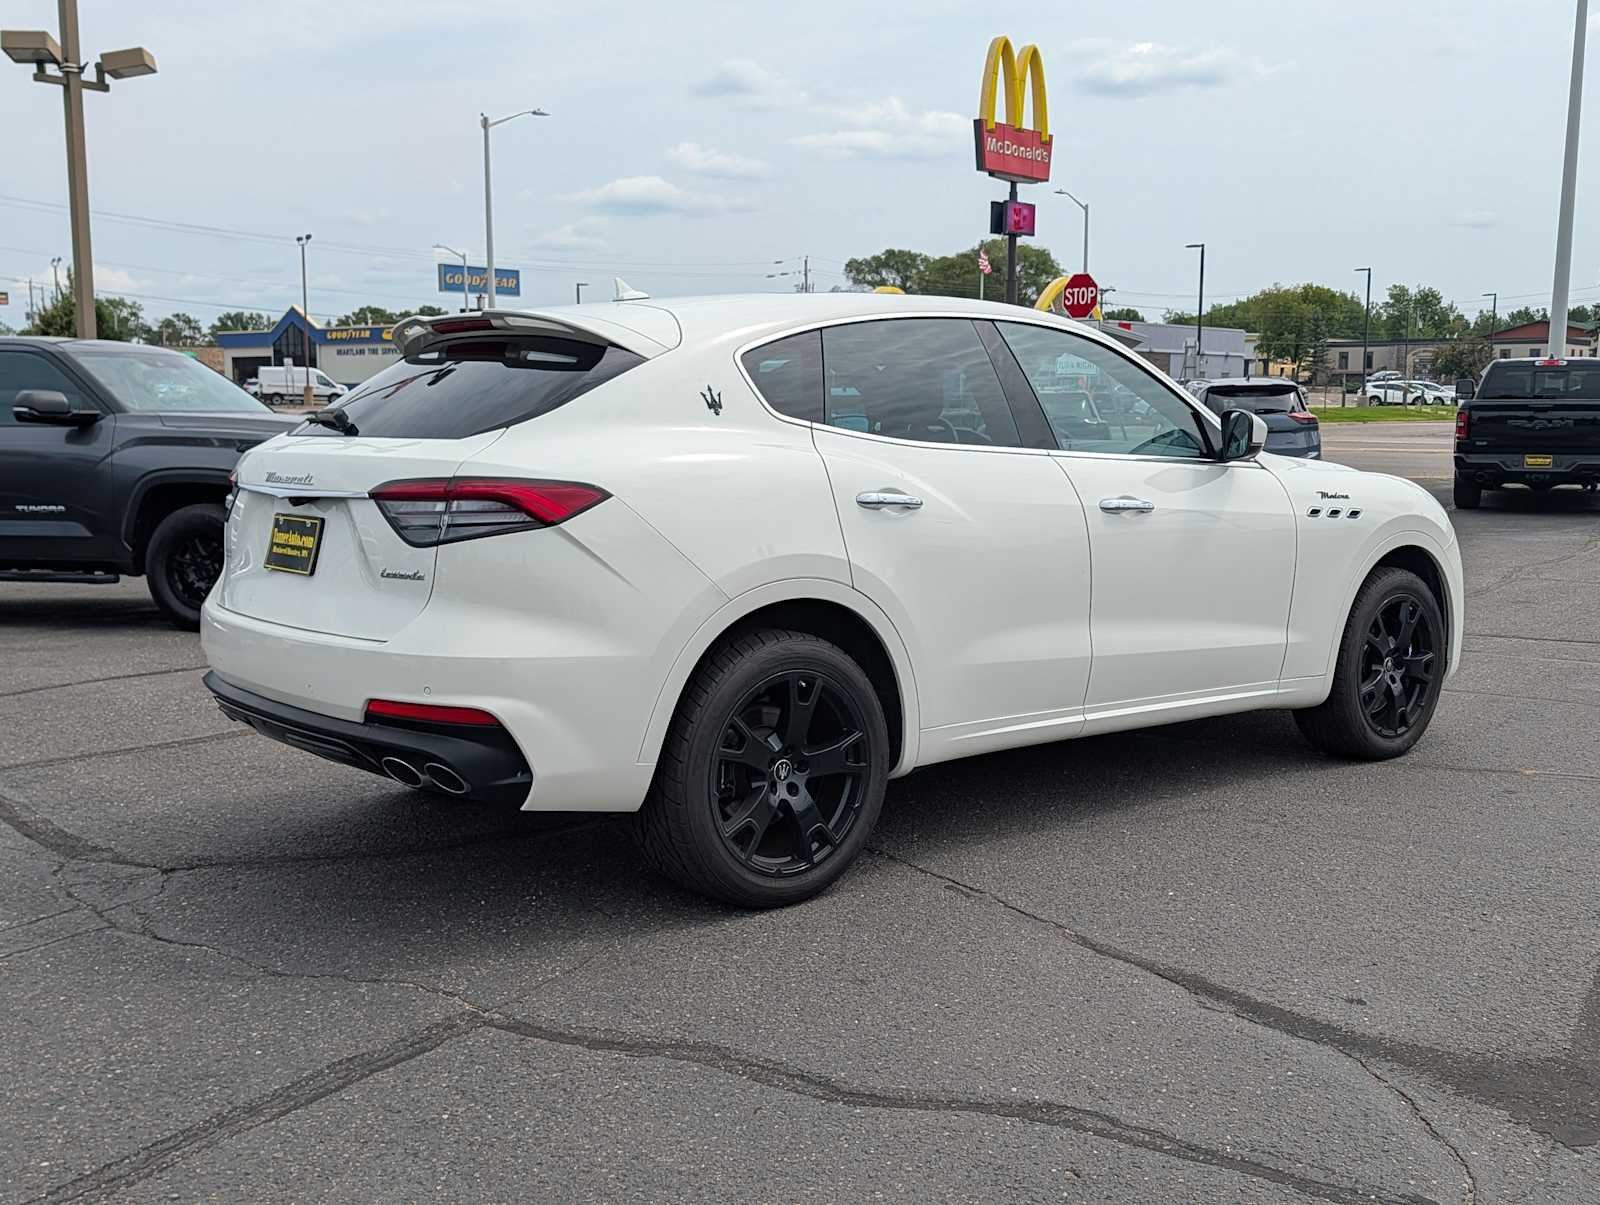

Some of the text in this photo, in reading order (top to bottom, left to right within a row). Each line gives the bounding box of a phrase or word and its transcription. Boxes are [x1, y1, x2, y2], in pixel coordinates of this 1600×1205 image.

[986, 136, 1049, 163] McDonald's
[445, 271, 517, 289] GOODEAR
[1065, 287, 1096, 305] STOP
[326, 328, 371, 340] GOODYEAR
